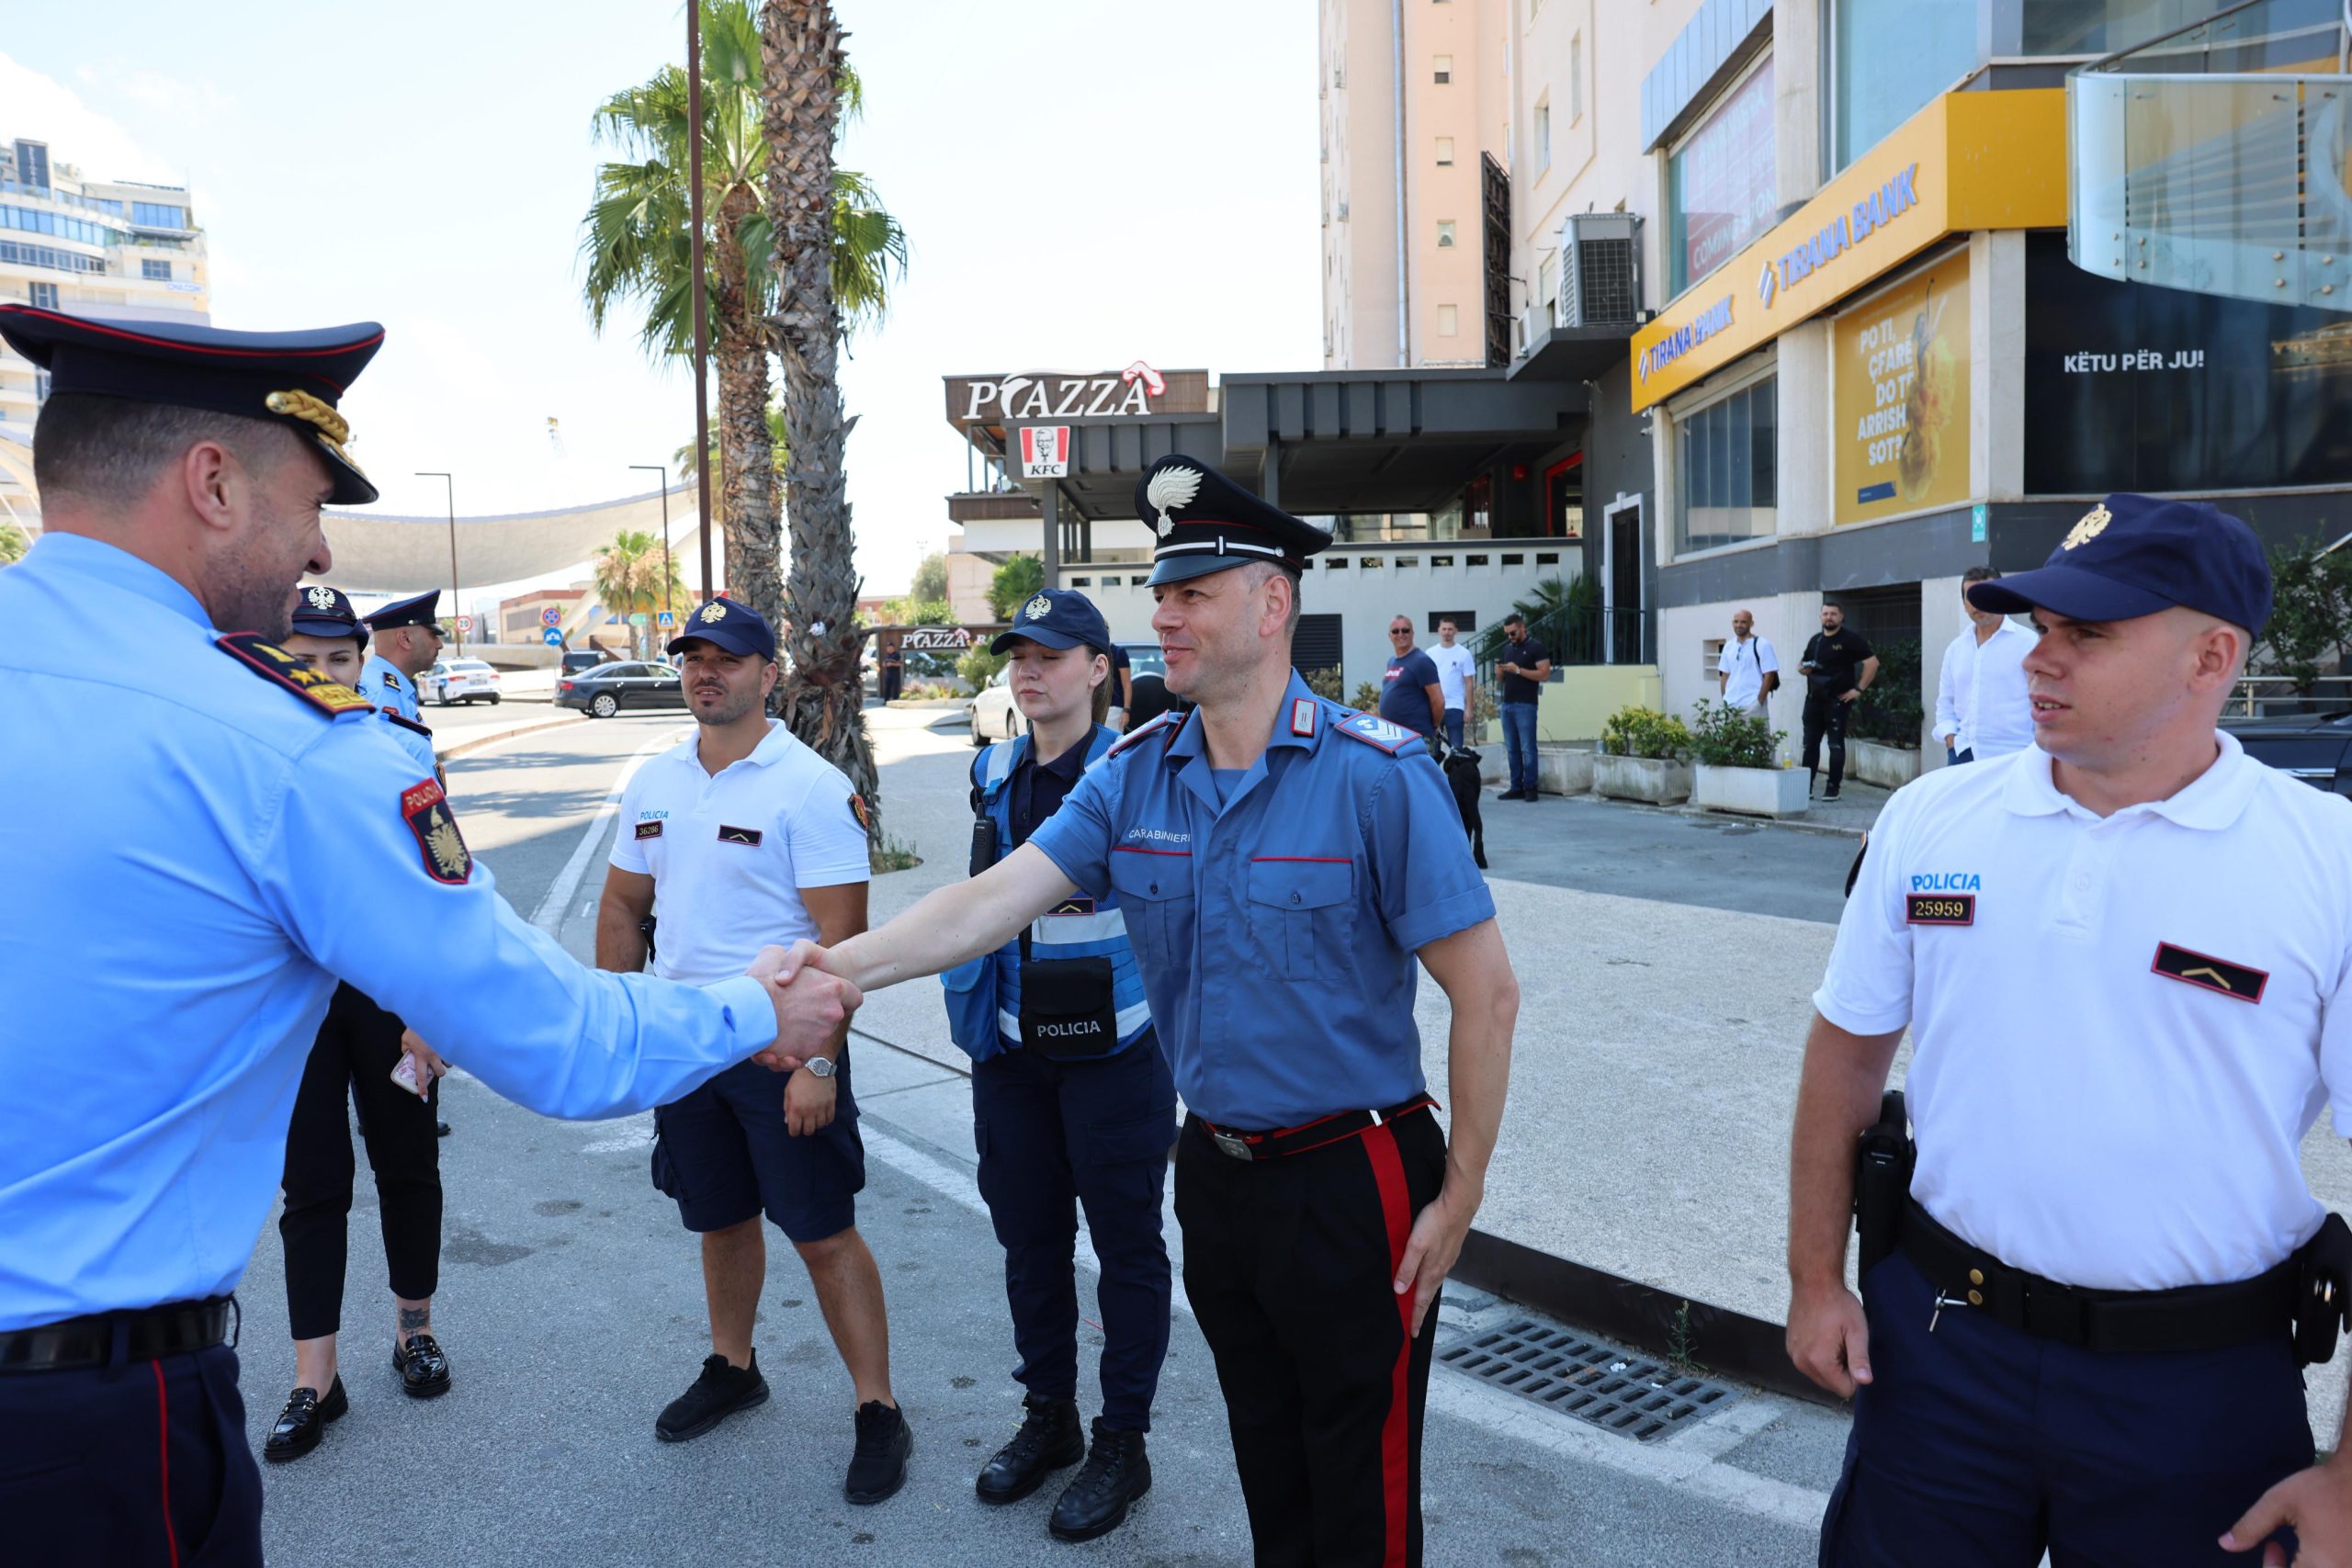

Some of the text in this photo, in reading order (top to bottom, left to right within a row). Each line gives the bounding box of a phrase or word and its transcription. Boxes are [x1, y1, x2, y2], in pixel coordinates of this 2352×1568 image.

[1777, 214, 1850, 292] TIRANA
[1852, 162, 1919, 244] BANK
[1649, 293, 1734, 374] TIRANA BANK
[1860, 324, 1878, 354] PO
[2064, 349, 2204, 373] KËTU PËR JU!
[1876, 378, 1896, 407] DO
[1857, 402, 1906, 440] ARRISH
[1868, 434, 1903, 466] SOT?
[1031, 464, 1060, 475] KFC
[459, 619, 469, 627] 20
[640, 810, 669, 819] POLICIA
[1128, 829, 1191, 843] CARABINIERI
[1911, 873, 1981, 891] POLICIA
[1915, 901, 1963, 917] 25959
[1036, 1021, 1102, 1037] POLICIA
